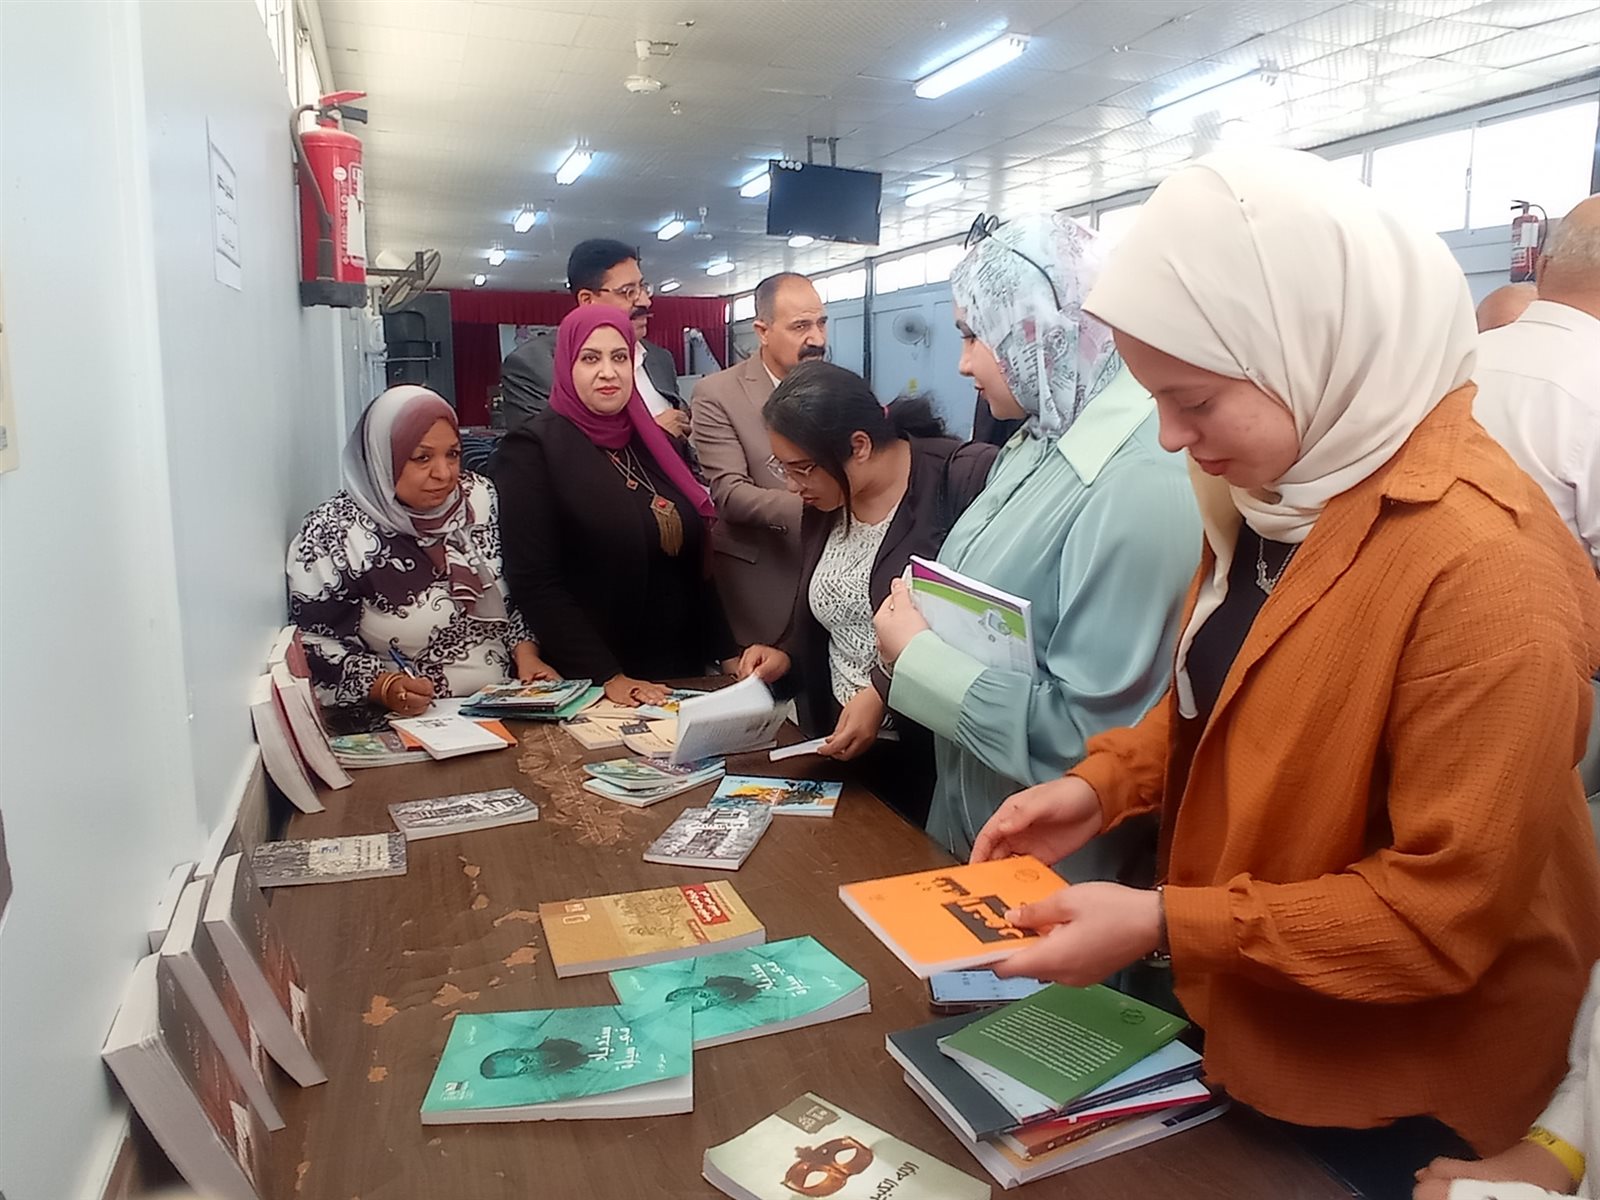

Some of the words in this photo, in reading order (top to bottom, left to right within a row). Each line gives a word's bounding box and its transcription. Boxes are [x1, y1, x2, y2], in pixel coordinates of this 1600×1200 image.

[588, 1026, 612, 1062] سندباد
[615, 1027, 634, 1046] في
[614, 1046, 642, 1071] سيارة
